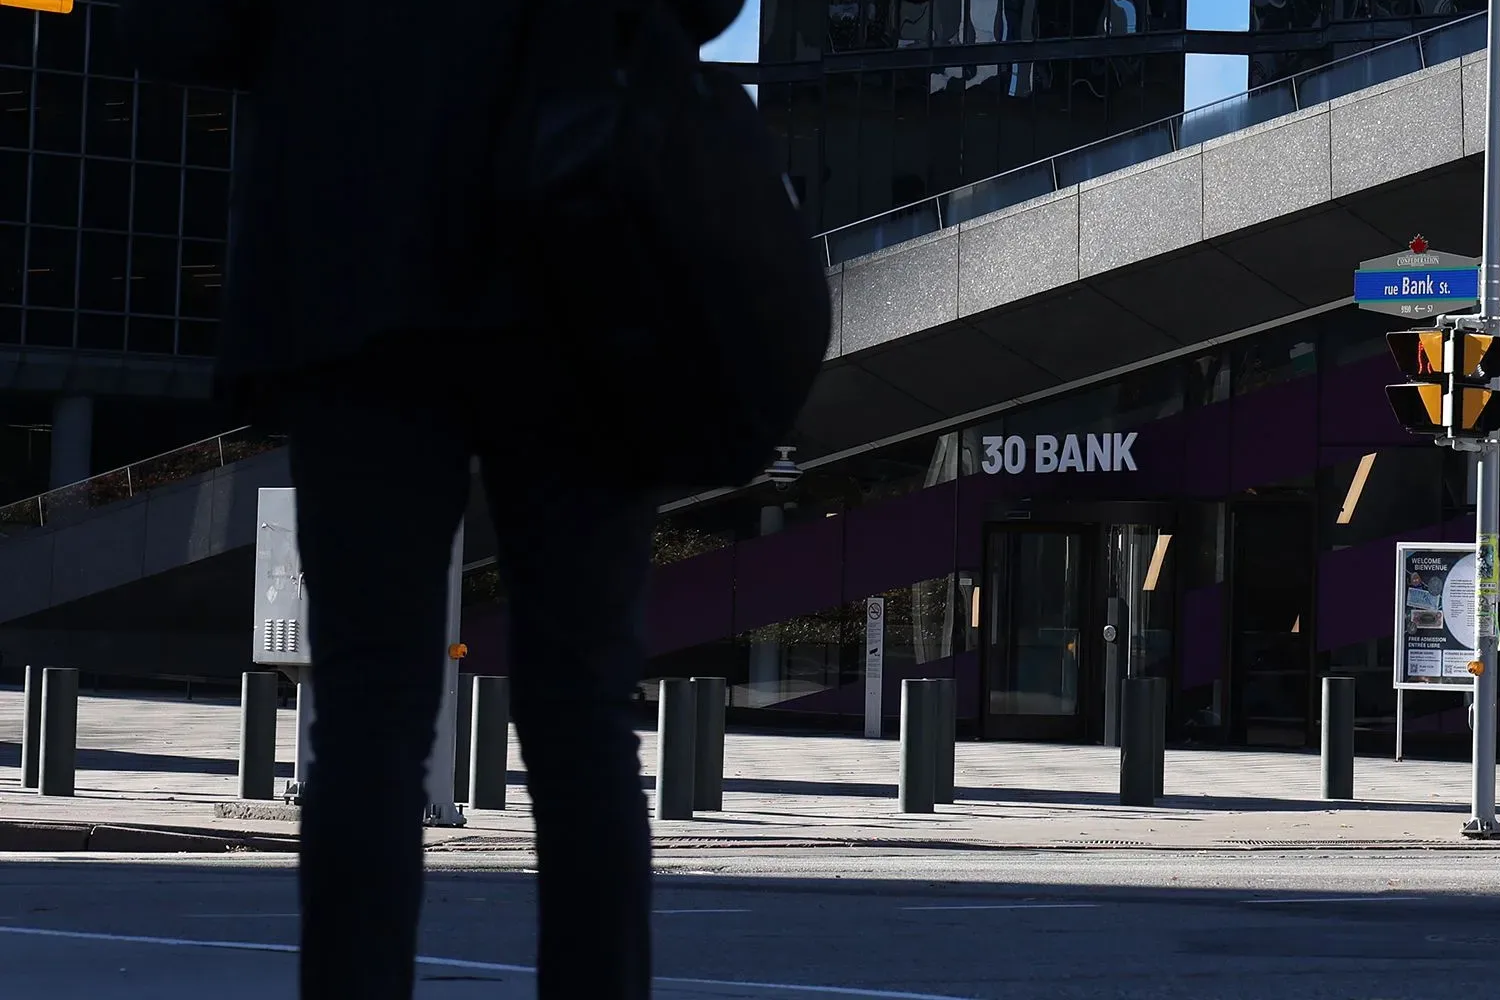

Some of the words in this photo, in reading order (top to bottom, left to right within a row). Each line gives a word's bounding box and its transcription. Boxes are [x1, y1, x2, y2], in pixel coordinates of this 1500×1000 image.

[1384, 284, 1398, 295] rue
[1402, 274, 1433, 295] Bank
[981, 434, 1026, 475] 30
[1035, 432, 1138, 473] BANK
